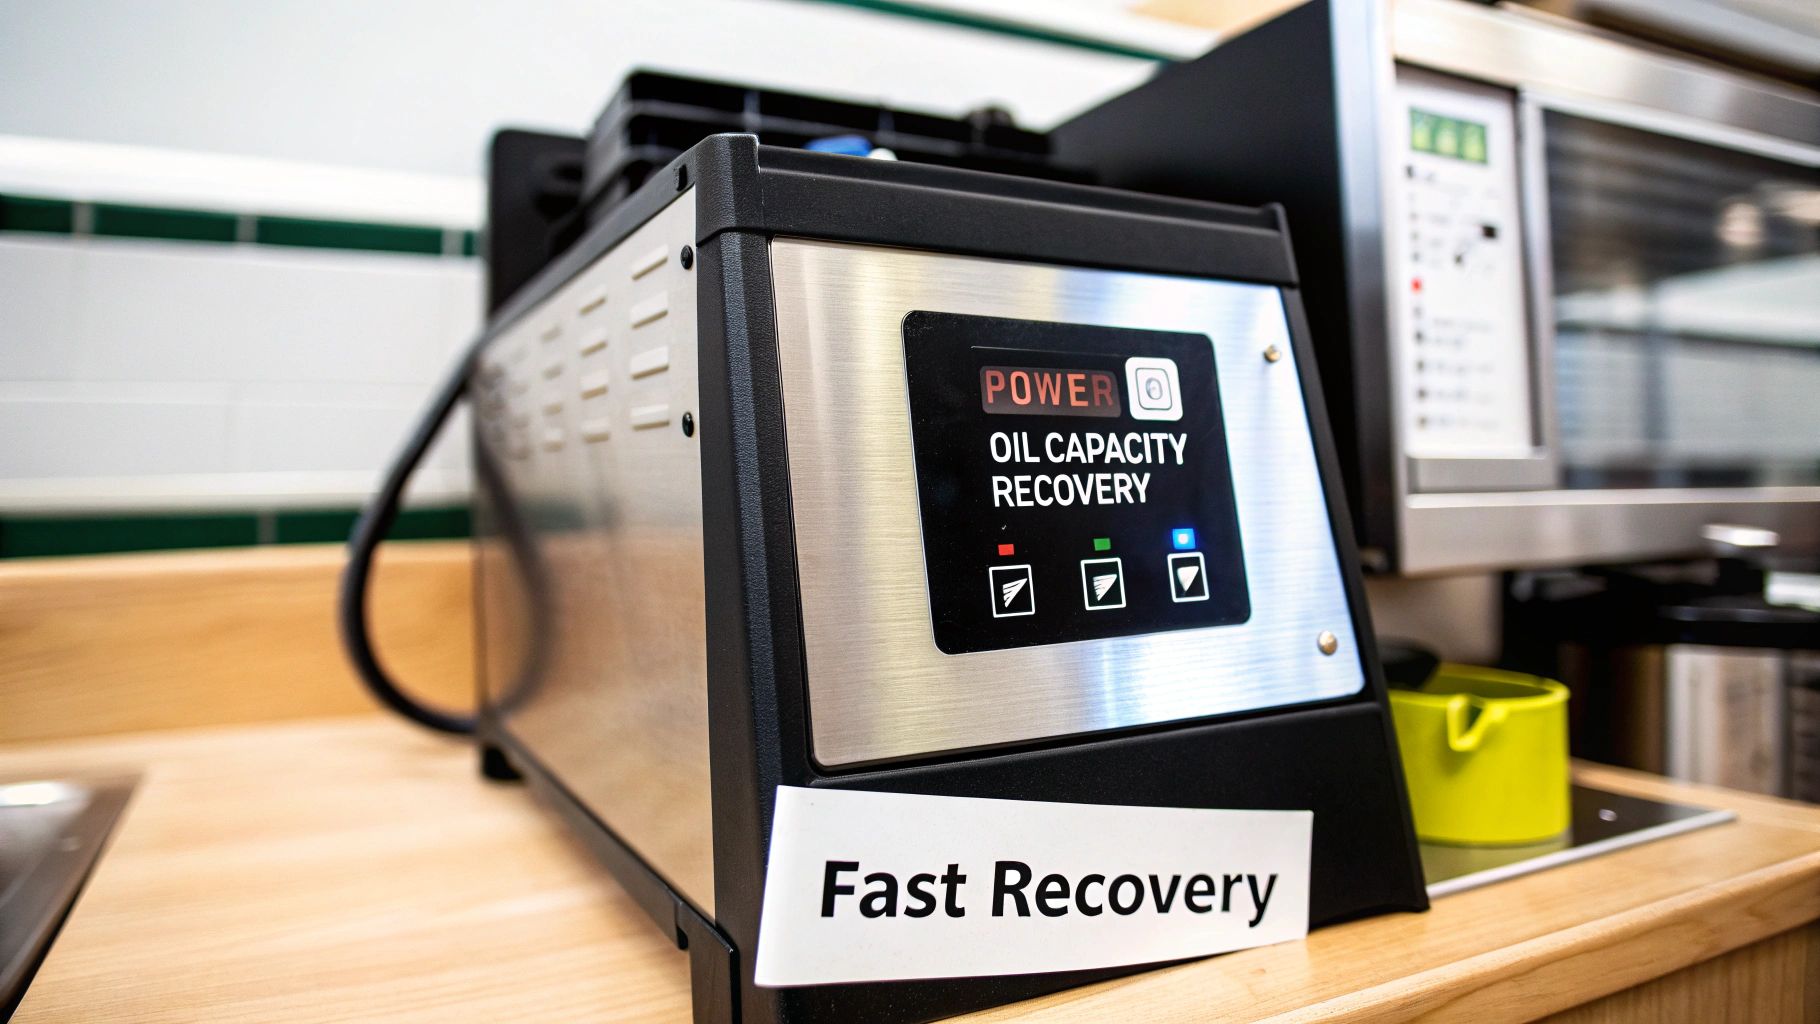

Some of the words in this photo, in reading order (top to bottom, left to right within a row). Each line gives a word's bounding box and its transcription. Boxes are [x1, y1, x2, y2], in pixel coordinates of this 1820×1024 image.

[984, 370, 1113, 407] POWER
[990, 431, 1041, 463] OIL
[1045, 432, 1188, 465] CAPACITY
[992, 473, 1151, 507] RECOVERY
[820, 860, 967, 919] Fast
[991, 860, 1277, 928] Recovery
